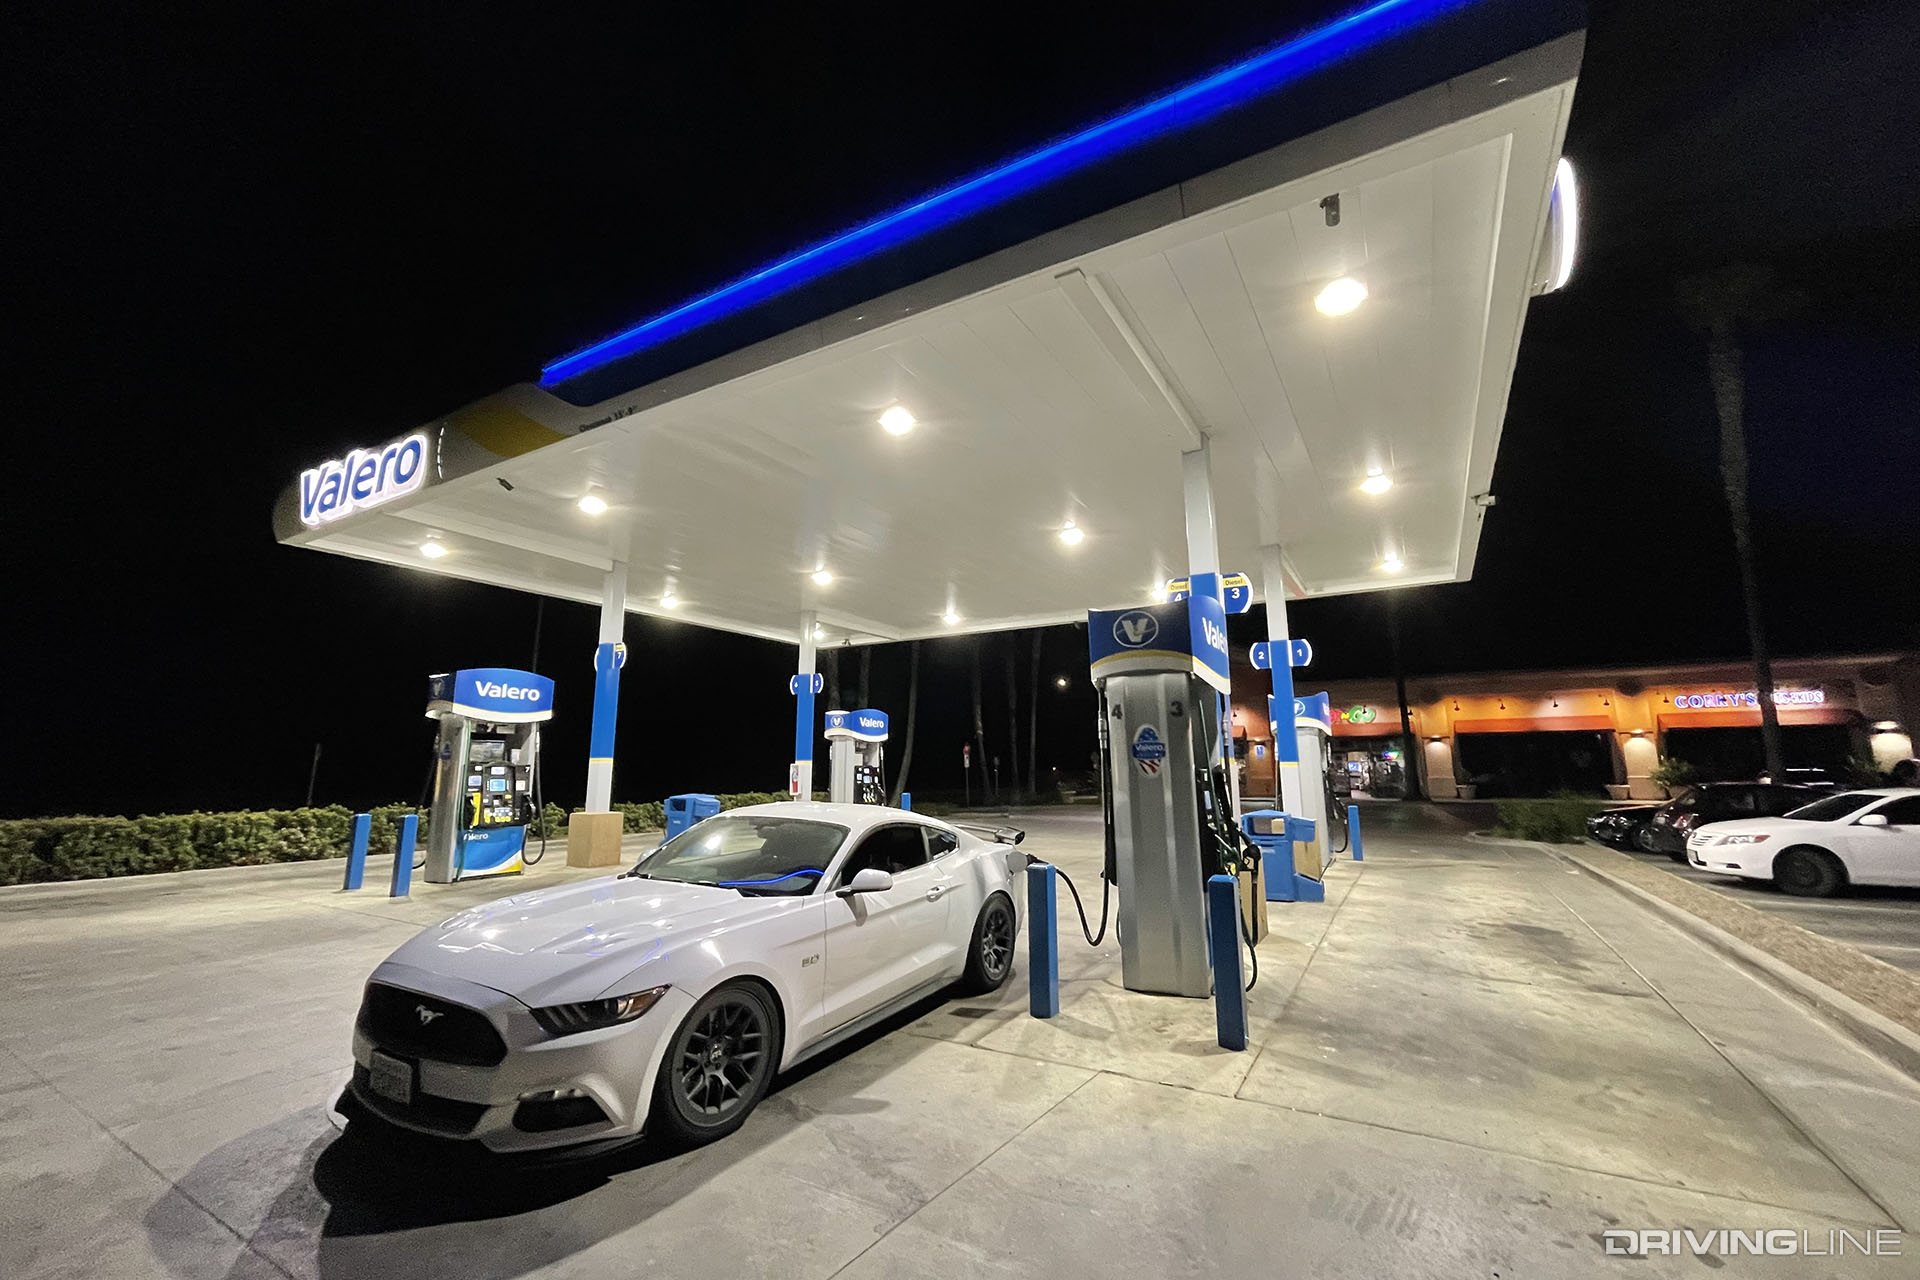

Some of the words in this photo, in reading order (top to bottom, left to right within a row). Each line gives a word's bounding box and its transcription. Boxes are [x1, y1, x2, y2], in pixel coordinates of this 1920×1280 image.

[303, 439, 421, 519] Valero
[1174, 592, 1183, 601] 4
[1231, 587, 1240, 599] 3
[1258, 652, 1265, 660] 2
[1296, 649, 1302, 657] 1
[475, 680, 540, 702] Valero
[1111, 703, 1123, 720] 4
[1170, 700, 1184, 718] 3
[859, 716, 885, 729] Valero
